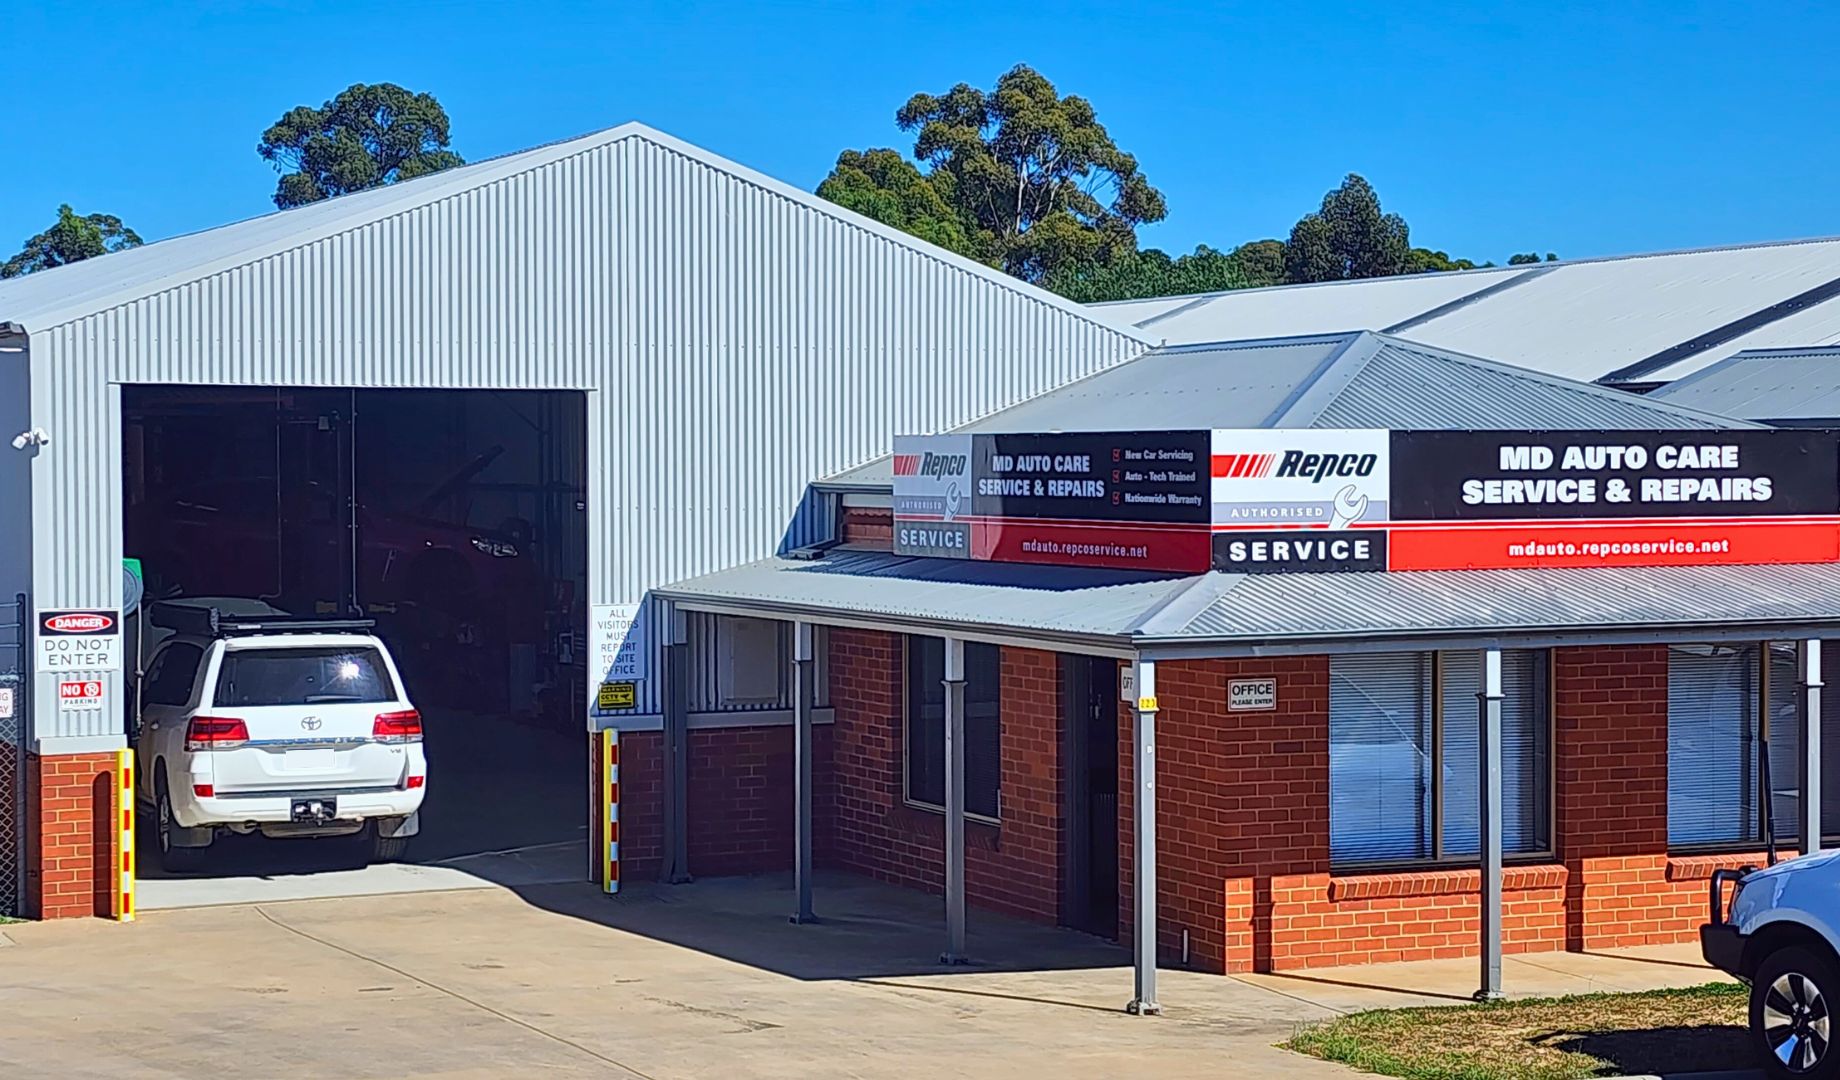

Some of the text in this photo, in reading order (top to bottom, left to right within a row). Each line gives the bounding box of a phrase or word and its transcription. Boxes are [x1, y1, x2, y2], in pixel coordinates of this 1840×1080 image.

[1125, 450, 1193, 461] New Car Servicing
[1499, 445, 1739, 470] MD AUTO CARE
[920, 451, 967, 481] Repco
[993, 455, 1090, 472] MD AUTO CARE
[1275, 450, 1378, 483] Repco
[1125, 471, 1142, 481] Auto
[1149, 471, 1167, 481] Tech
[1168, 471, 1196, 481] Trained
[978, 479, 1105, 497] SERVICE & REPAIRS
[1462, 477, 1773, 504] SERVICE & REPAIRS
[1125, 493, 1202, 506] Nationwide Warranty
[1231, 508, 1324, 518] AUTHORISED
[900, 529, 963, 548] SERVICE
[1022, 539, 1148, 558] mdauto.repcoservice.net
[1229, 540, 1370, 562] SERVICE
[1508, 540, 1729, 557] mdauto.repcoservice.net
[609, 609, 627, 618] ALL
[55, 618, 103, 628] DANGER
[598, 620, 639, 630] VISITORS
[606, 632, 630, 641] MUST
[45, 639, 112, 651] DO NOT
[601, 643, 636, 653] REPORT
[48, 653, 108, 665] ENTER
[603, 653, 636, 664] TO SITE
[602, 665, 636, 675] OFFICE
[62, 685, 80, 696] NO
[1232, 684, 1273, 696] OFFICE
